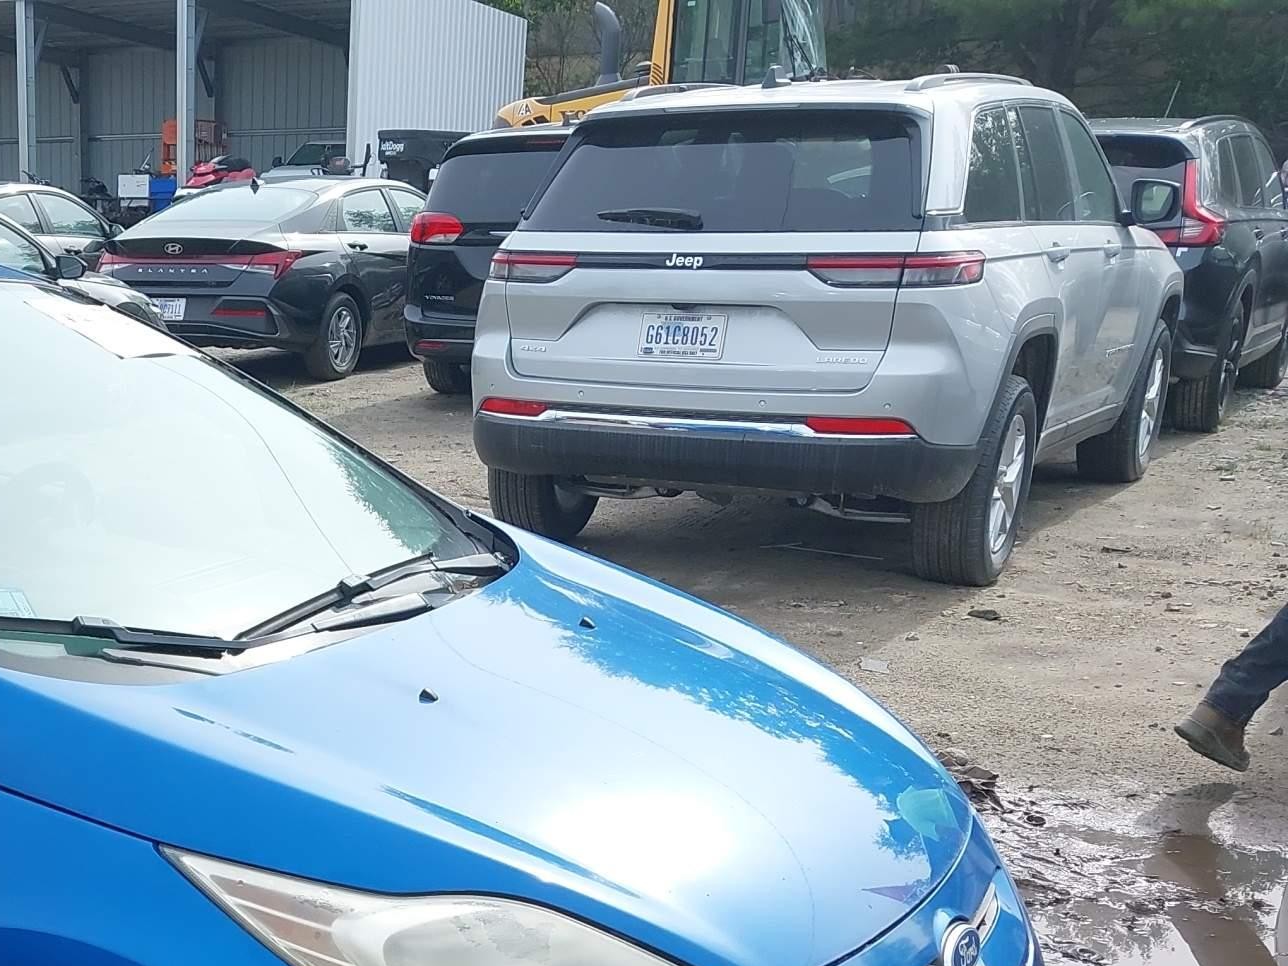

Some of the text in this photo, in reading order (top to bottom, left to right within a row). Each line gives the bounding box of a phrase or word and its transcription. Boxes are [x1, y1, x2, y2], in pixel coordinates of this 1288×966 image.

[665, 253, 703, 270] Jeep
[646, 325, 718, 346] G61C8052
[816, 356, 868, 365] LAREDO
